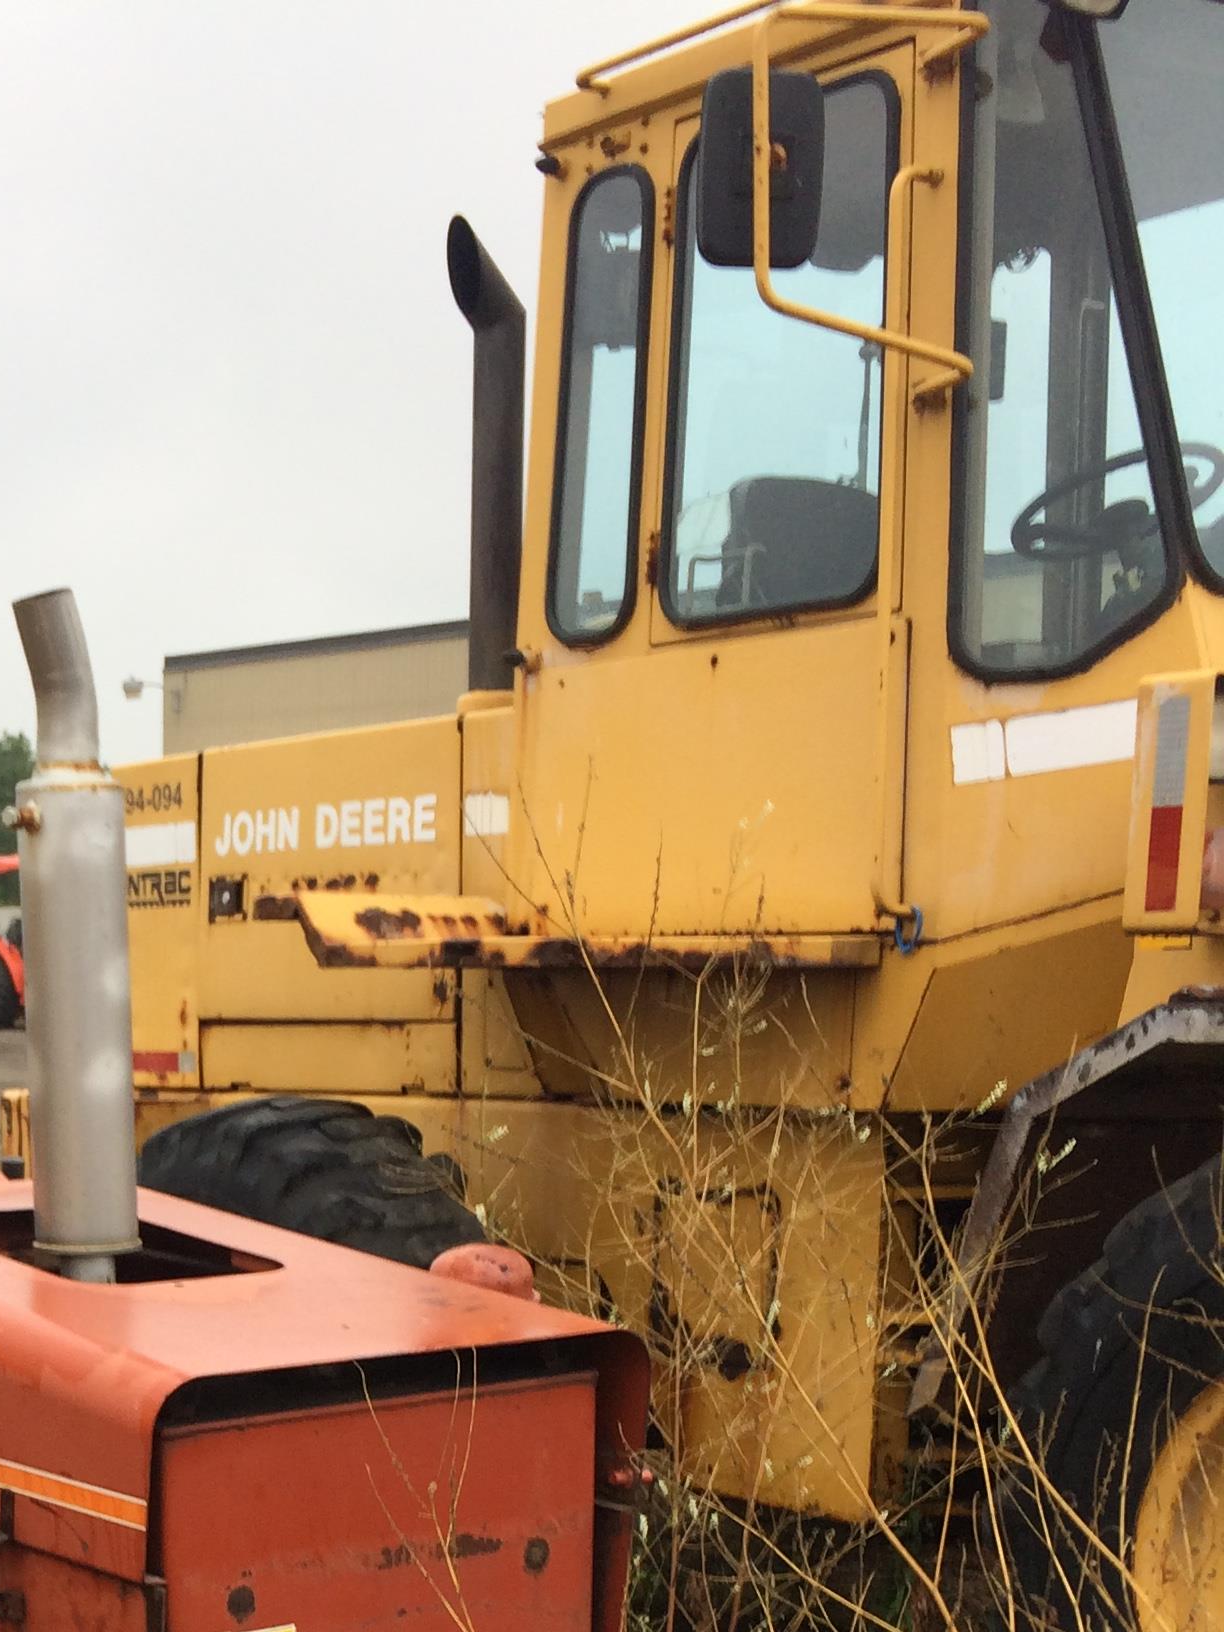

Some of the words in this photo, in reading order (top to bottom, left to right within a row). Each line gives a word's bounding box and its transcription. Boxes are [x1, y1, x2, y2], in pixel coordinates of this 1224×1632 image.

[214, 804, 300, 857] JOHN
[314, 793, 438, 850] DEERE
[126, 869, 192, 906] NTRAC
